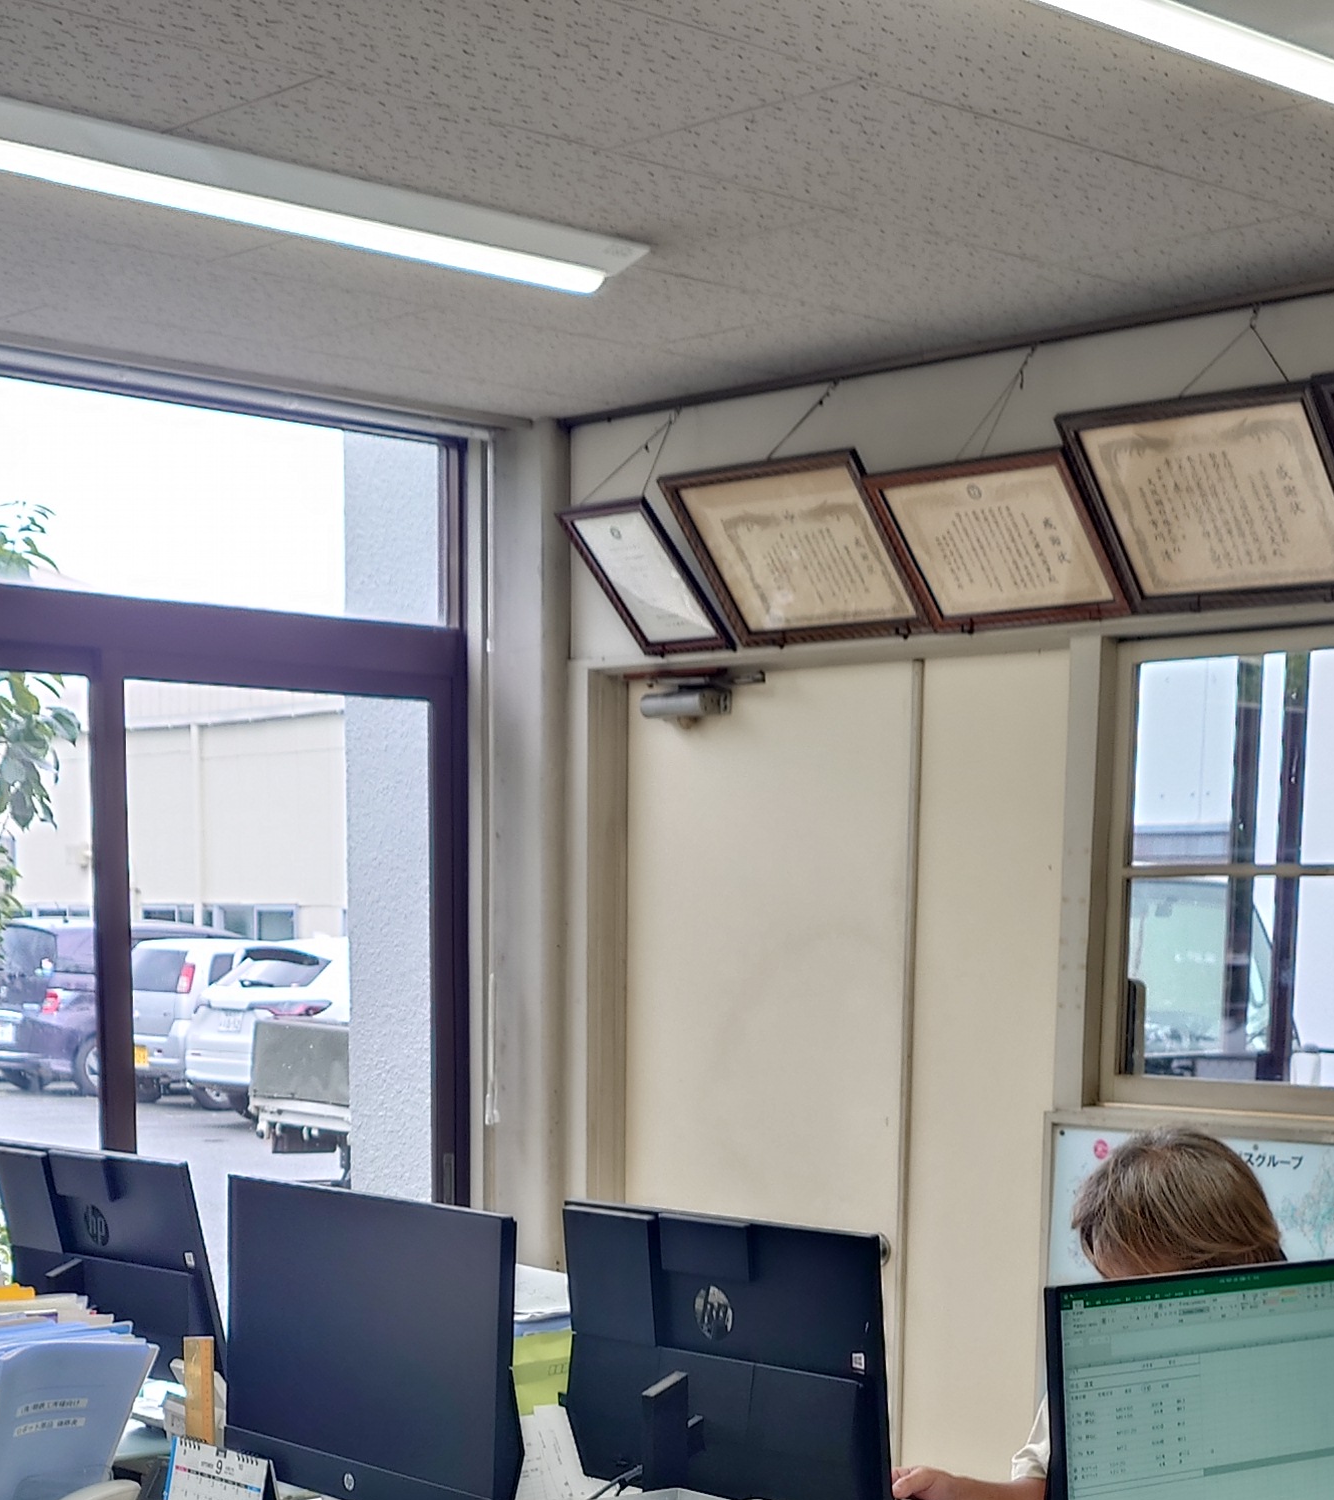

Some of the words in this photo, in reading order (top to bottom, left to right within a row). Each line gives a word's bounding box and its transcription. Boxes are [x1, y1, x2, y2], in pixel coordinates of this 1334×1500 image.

[1238, 1151, 1304, 1170] スグループ
[215, 1459, 224, 1475] 9
